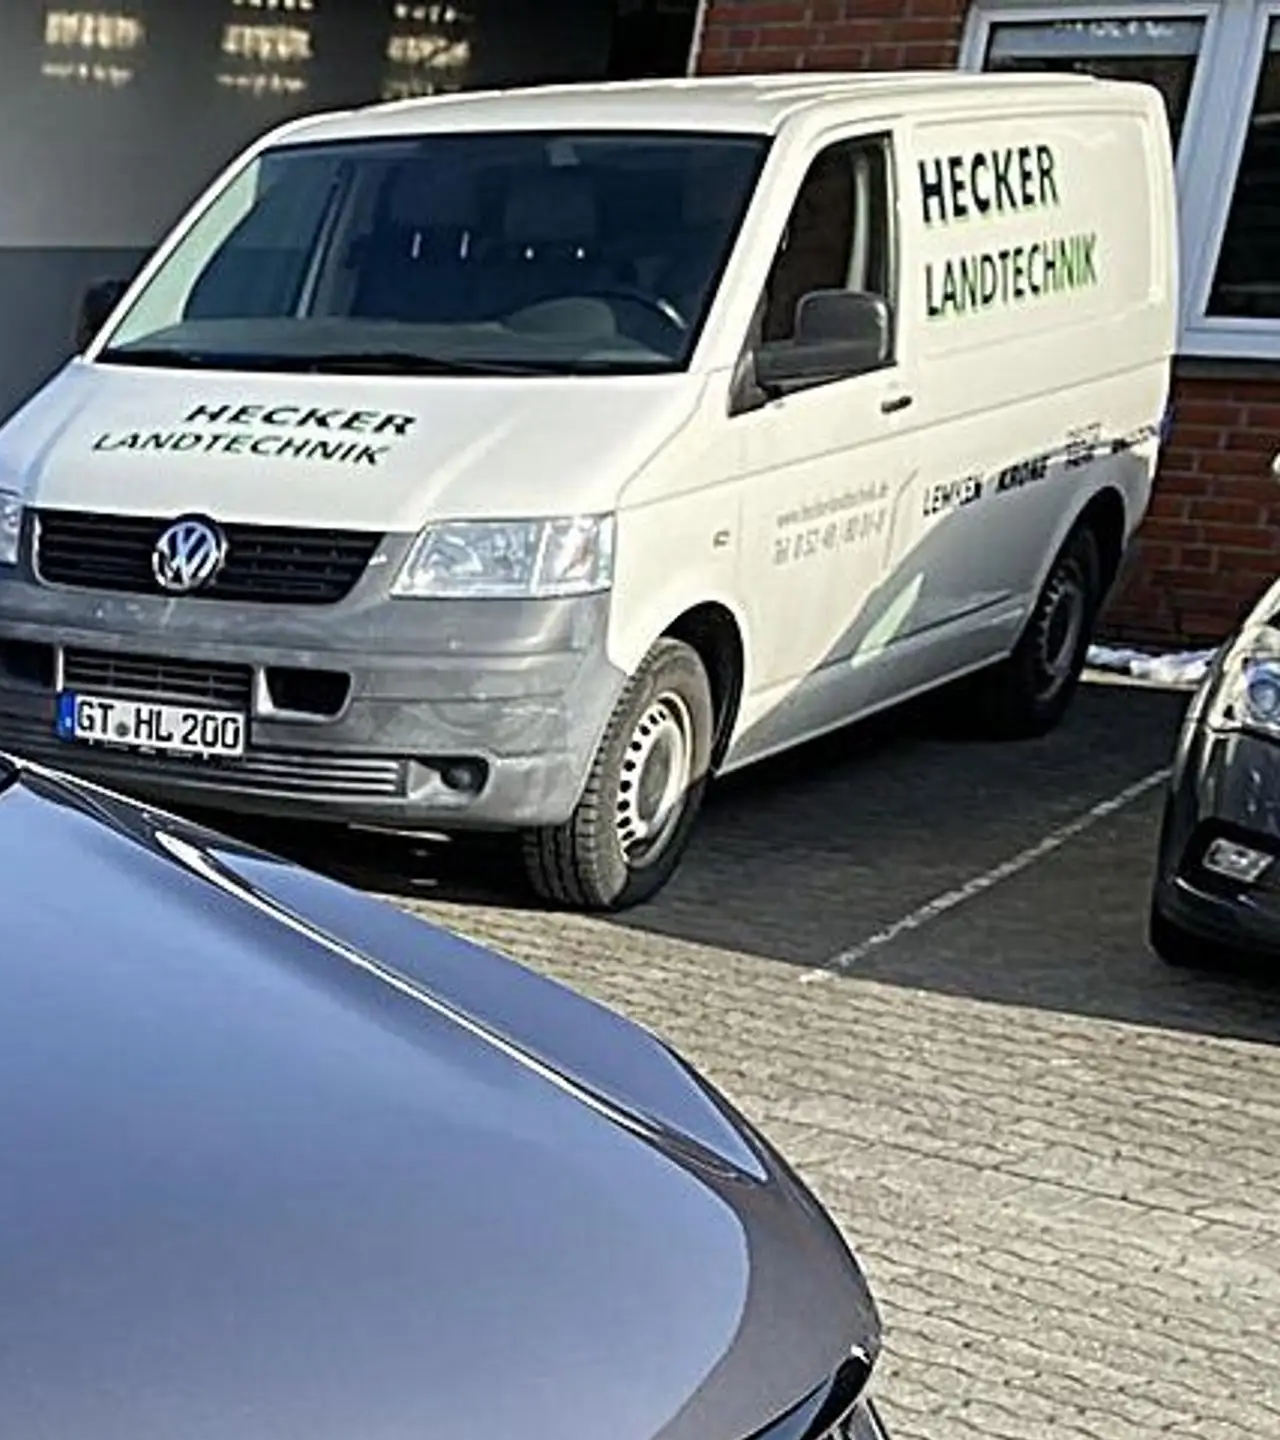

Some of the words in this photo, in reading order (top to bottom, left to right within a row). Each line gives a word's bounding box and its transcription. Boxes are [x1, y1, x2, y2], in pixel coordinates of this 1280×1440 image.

[918, 143, 1059, 224] HECKER
[925, 232, 1096, 316] LANDTECHNIK
[184, 403, 417, 435] HECKER
[90, 431, 391, 466] LANDTECHNIK
[181, 713, 241, 749] 200
